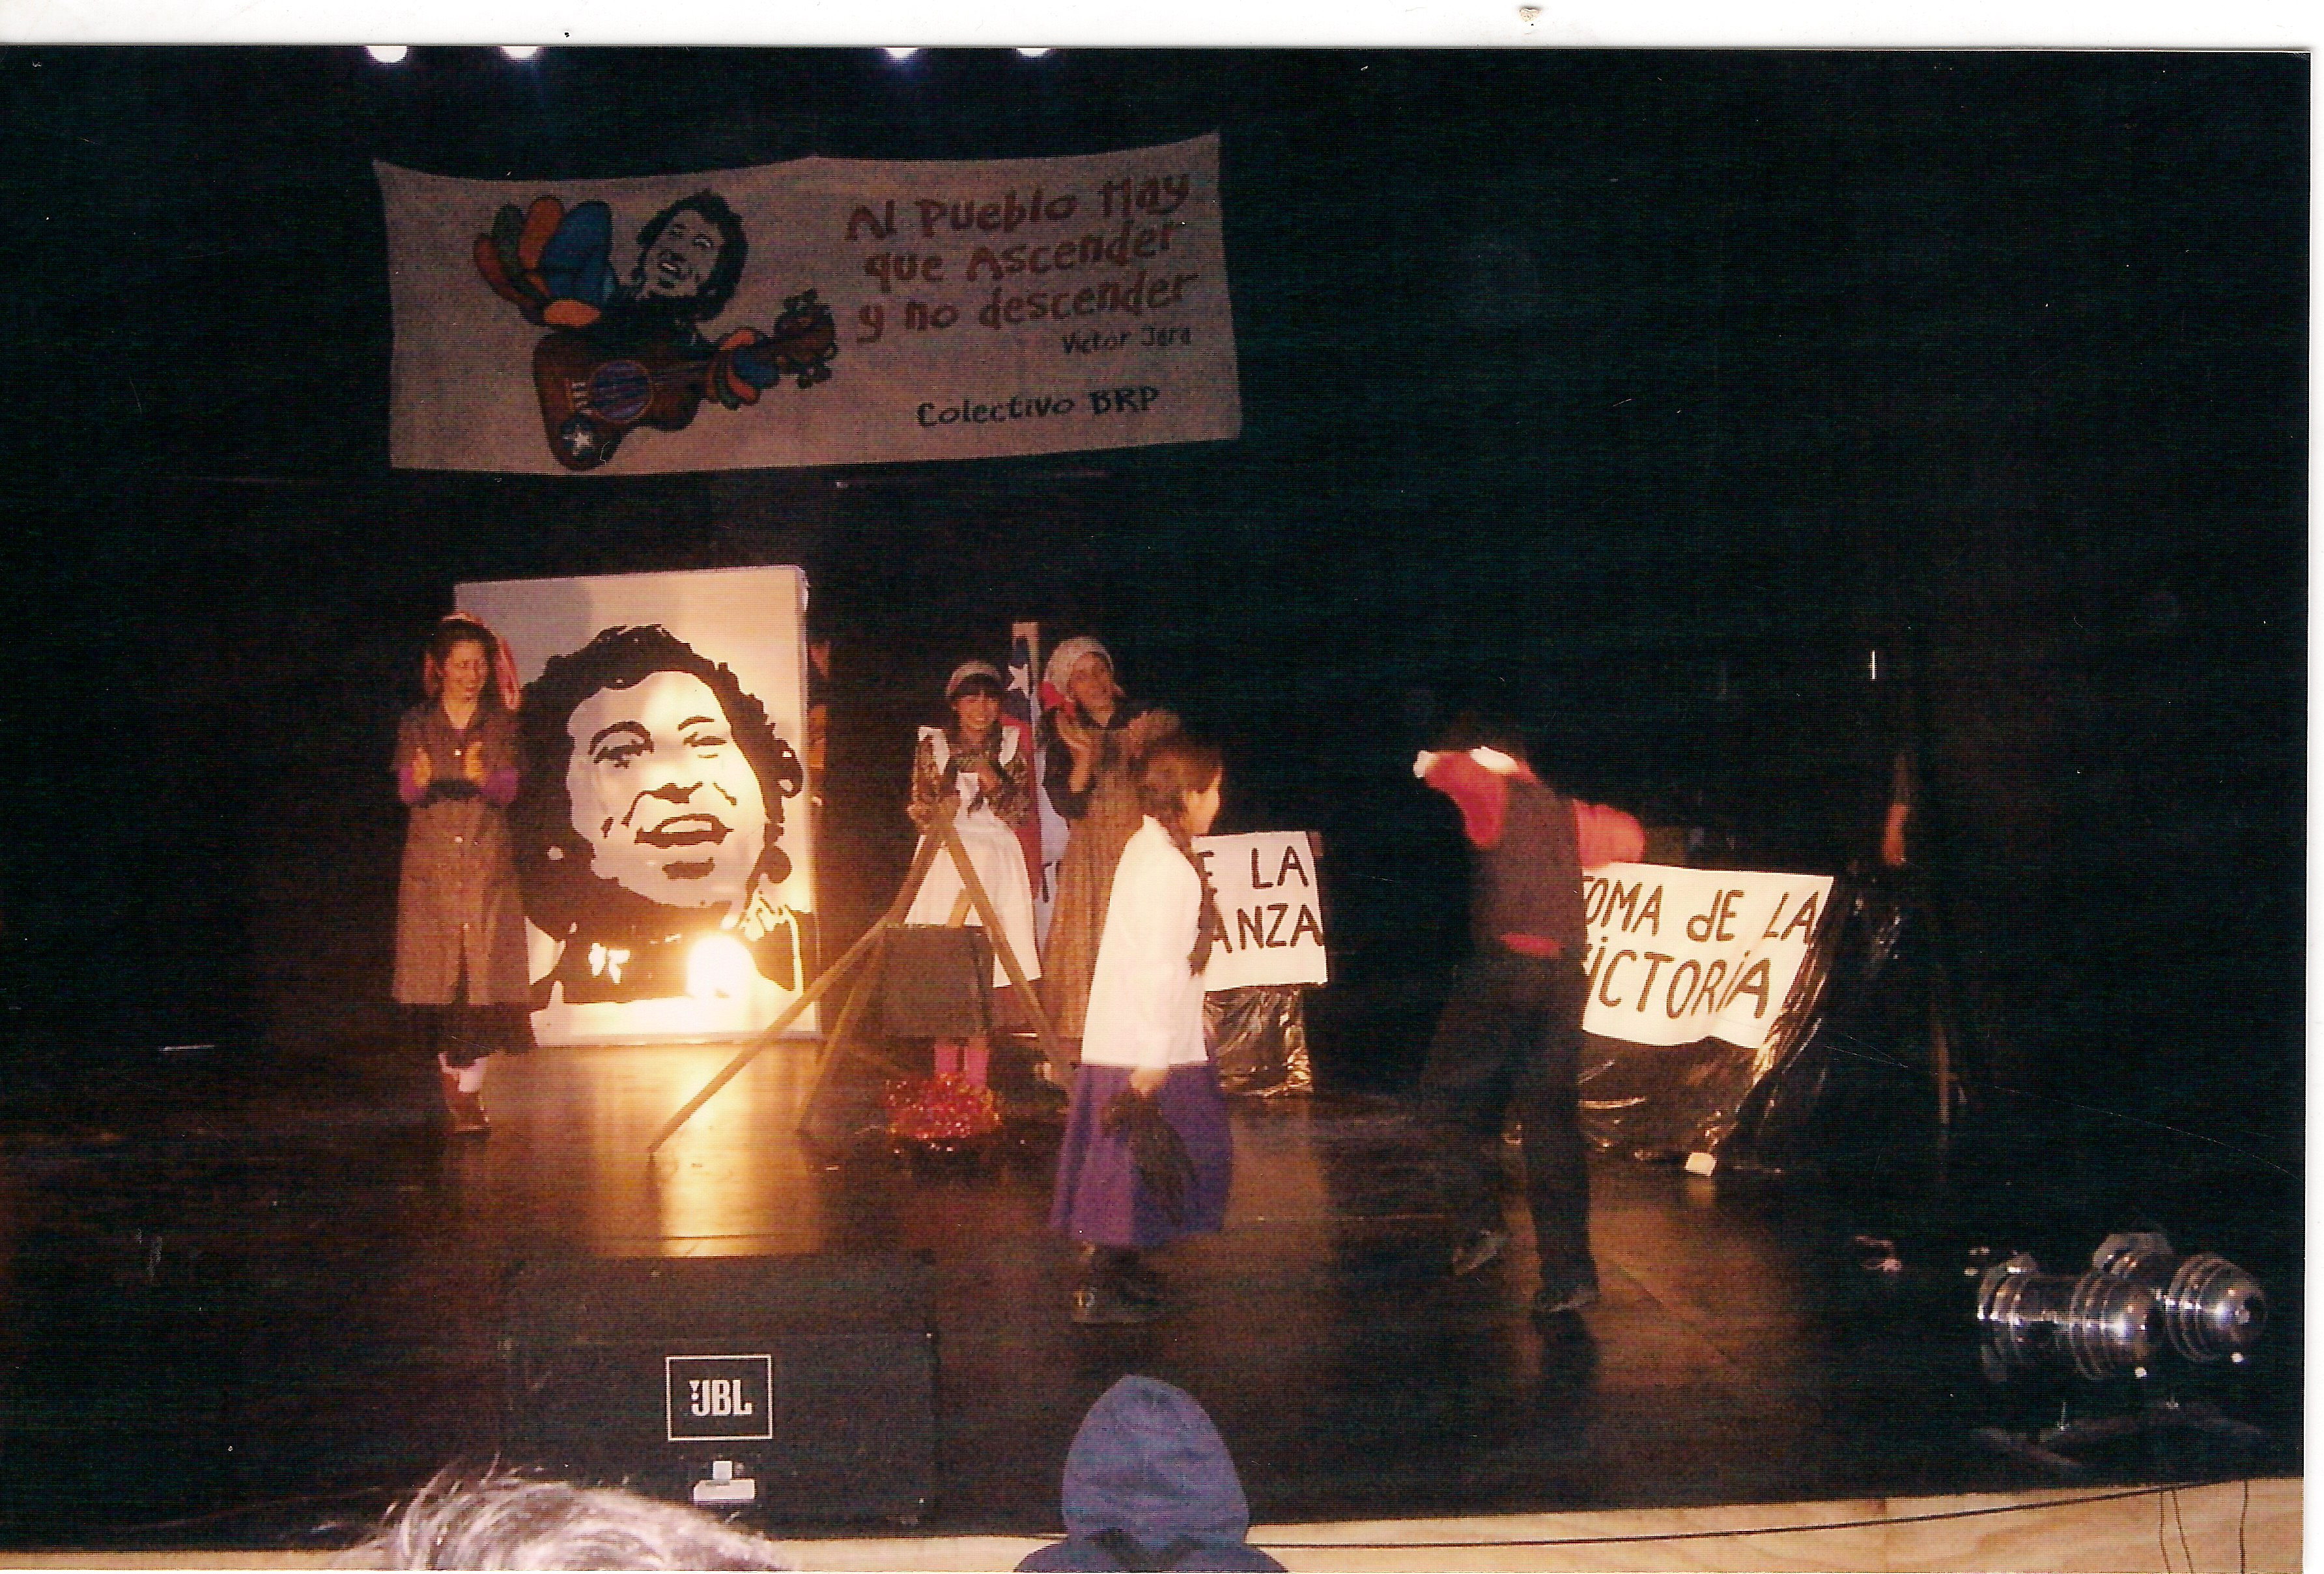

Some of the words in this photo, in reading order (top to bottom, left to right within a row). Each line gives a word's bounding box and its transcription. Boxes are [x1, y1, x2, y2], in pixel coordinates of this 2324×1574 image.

[845, 199, 897, 241] Al
[913, 190, 1078, 238] Pueblo
[1097, 173, 1190, 218] Hay
[863, 252, 944, 293] que
[967, 220, 1176, 281] Ascender
[857, 304, 885, 343] y
[904, 300, 960, 331] no
[978, 269, 1198, 330] descender
[916, 395, 1075, 428] Colectivo
[1088, 386, 1161, 416] BRP
[1251, 846, 1309, 889] LA
[1210, 903, 1324, 953] ANZA
[1582, 876, 1663, 936] OMA
[1762, 891, 1820, 943] LA
[688, 1379, 753, 1416] JBL
